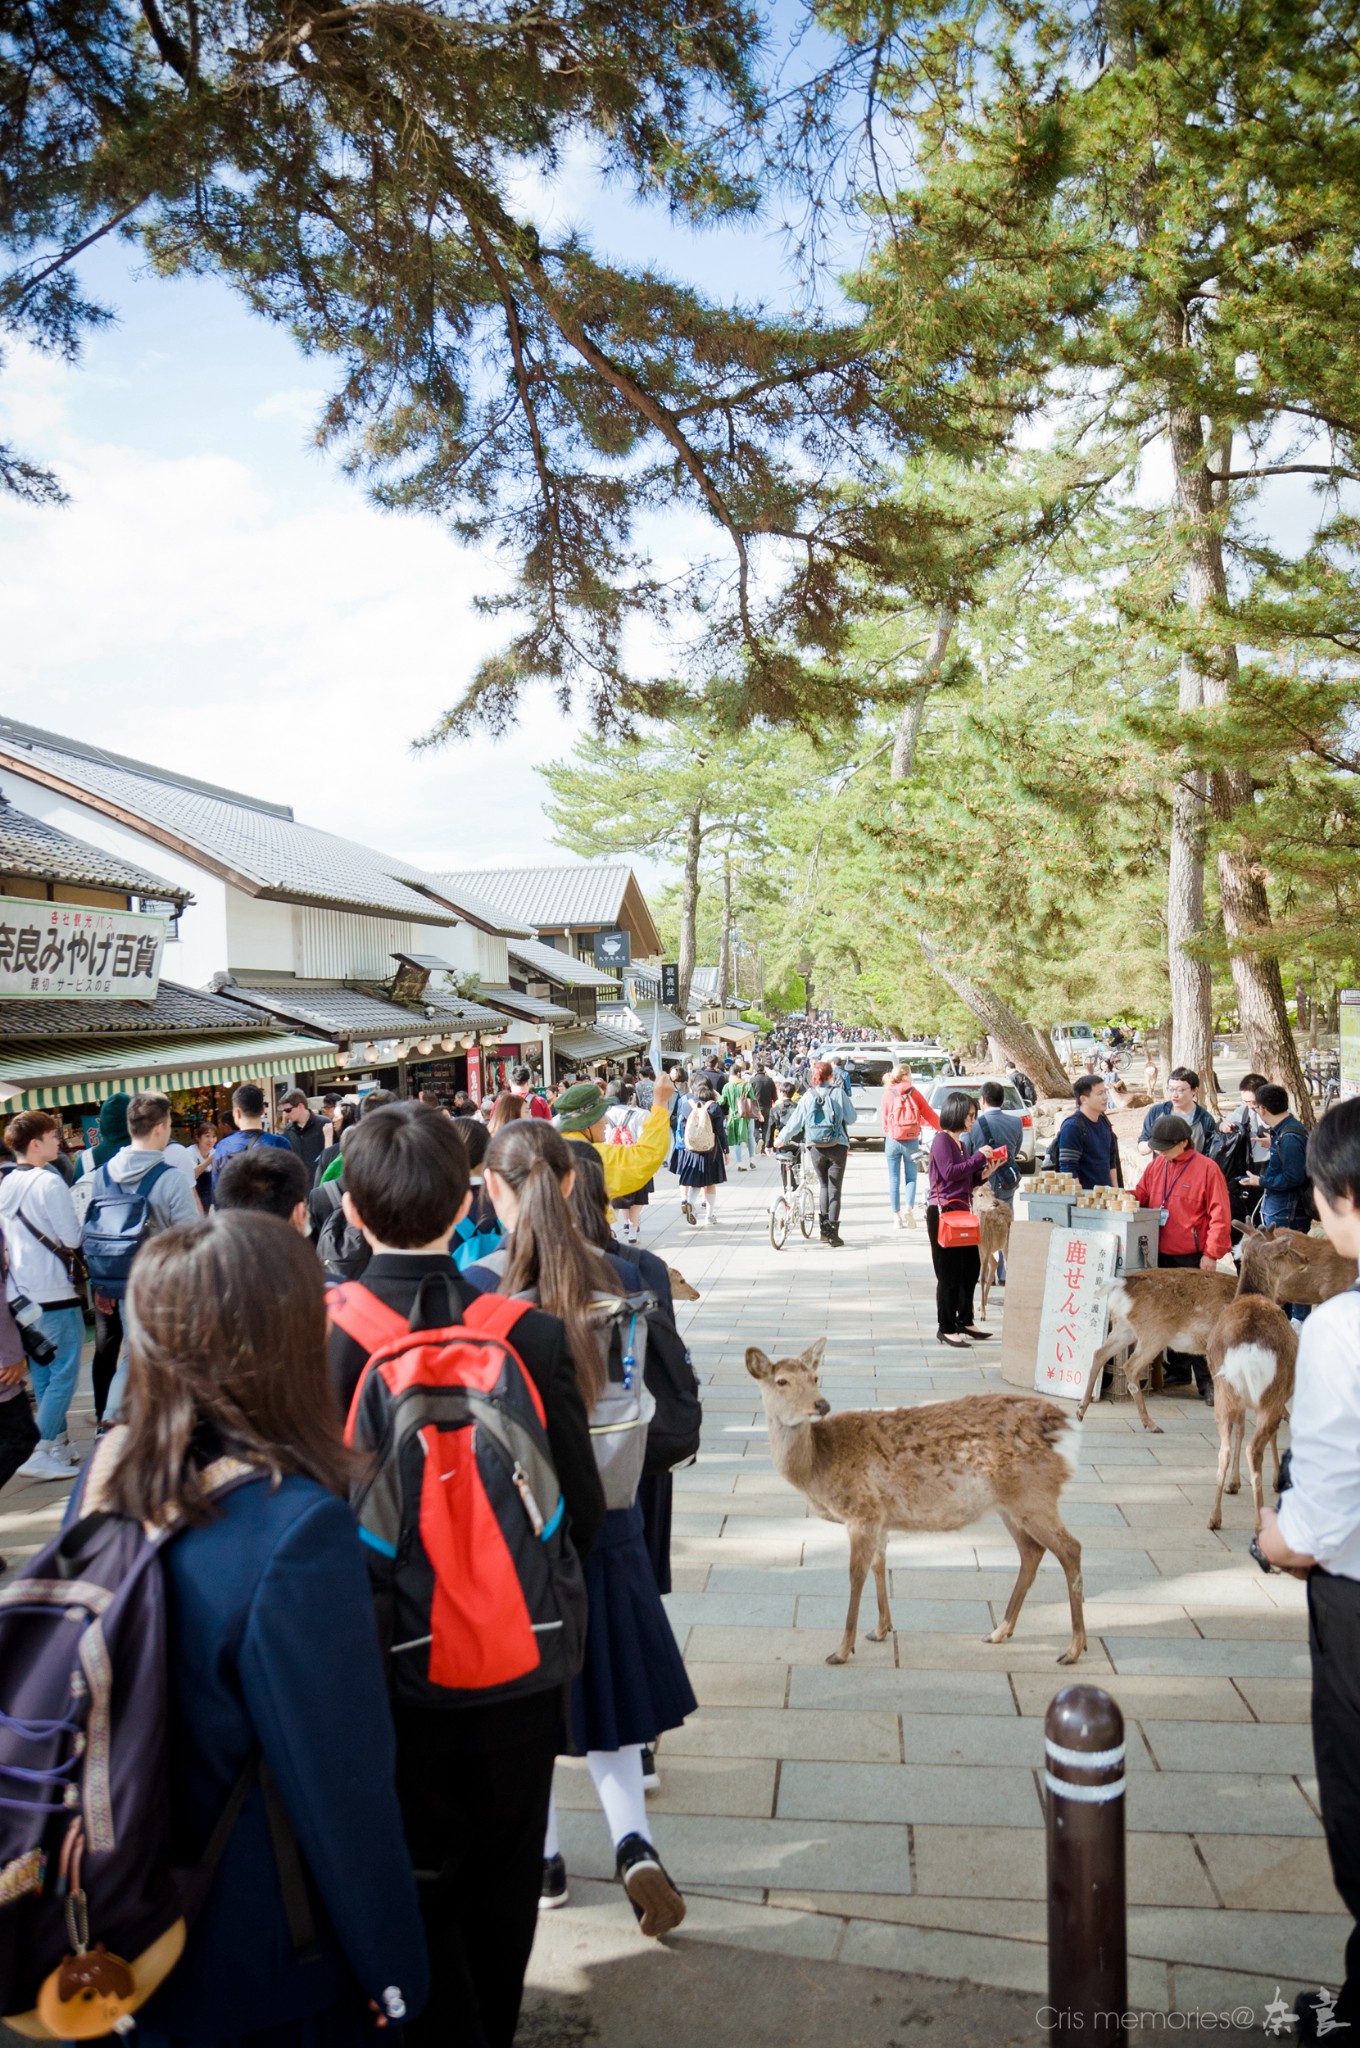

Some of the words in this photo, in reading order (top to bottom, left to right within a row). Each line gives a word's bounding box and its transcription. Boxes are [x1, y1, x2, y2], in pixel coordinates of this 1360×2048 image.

[0, 922, 158, 978] 奈良みやげ百貨
[1056, 1240, 1088, 1362] 鹿せんべい
[1089, 1248, 1107, 1328] 奈良鹿護会
